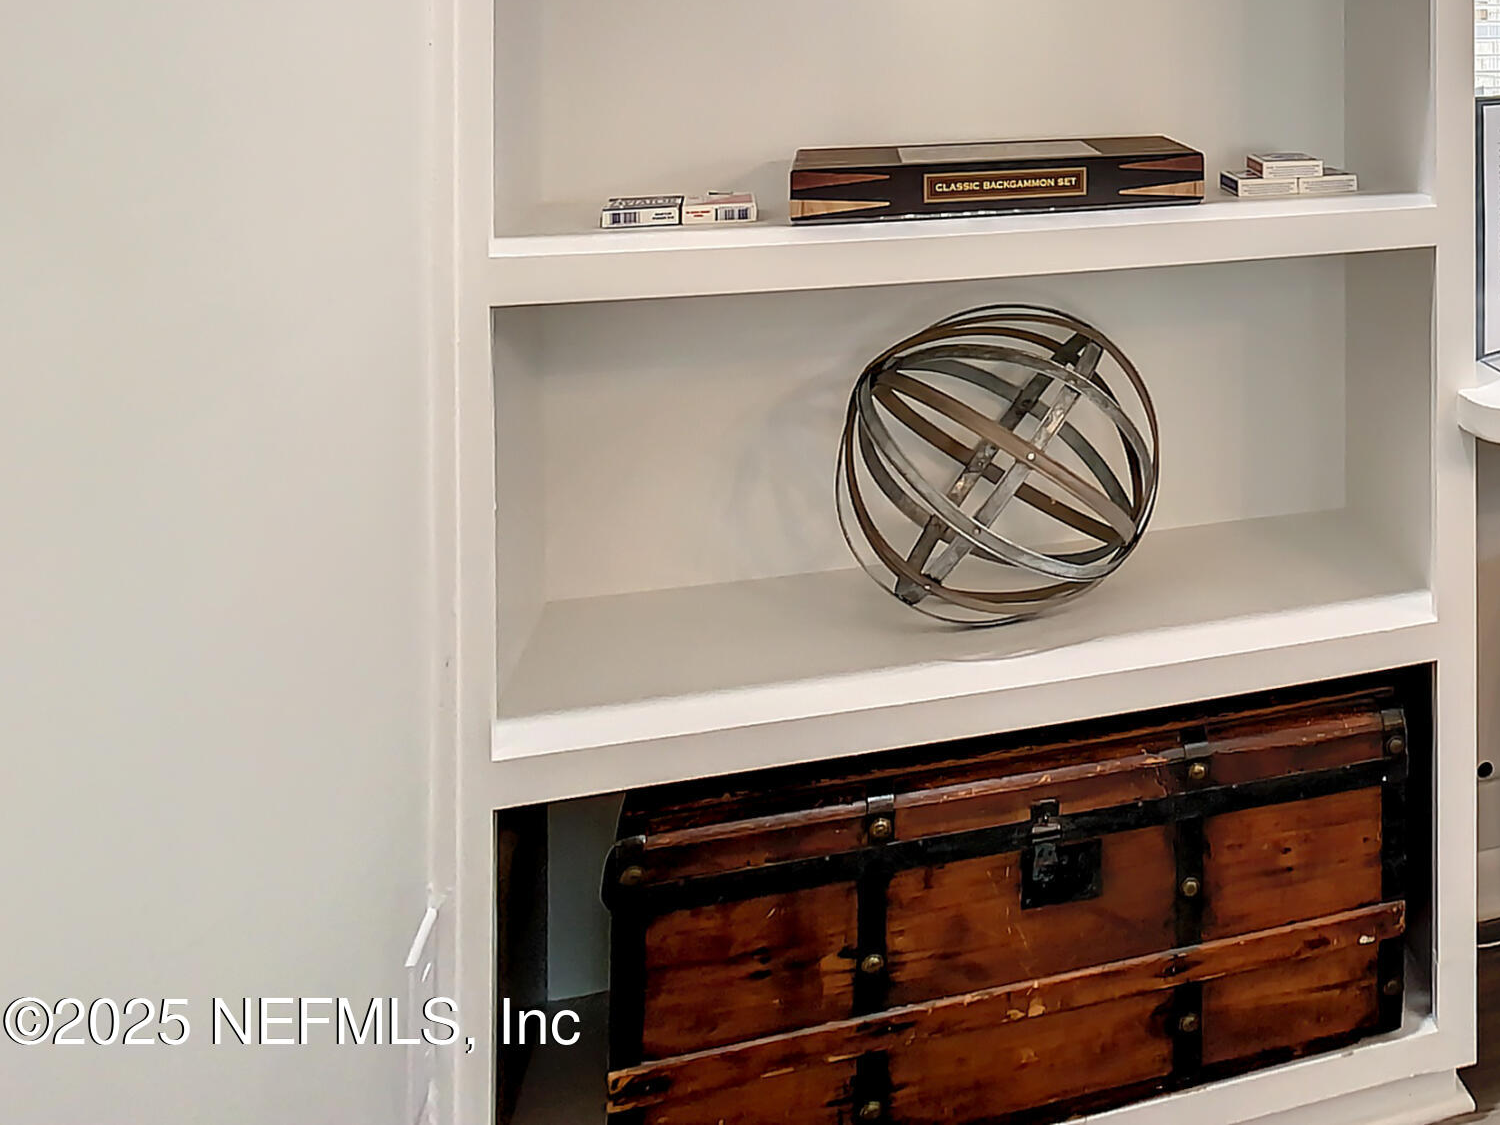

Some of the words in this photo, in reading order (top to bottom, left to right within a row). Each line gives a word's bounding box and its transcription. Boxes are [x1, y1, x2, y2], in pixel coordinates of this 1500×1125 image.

[935, 182, 980, 192] CLASSIC
[983, 178, 1055, 190] BACKGAMMON
[1057, 177, 1077, 186] SET
